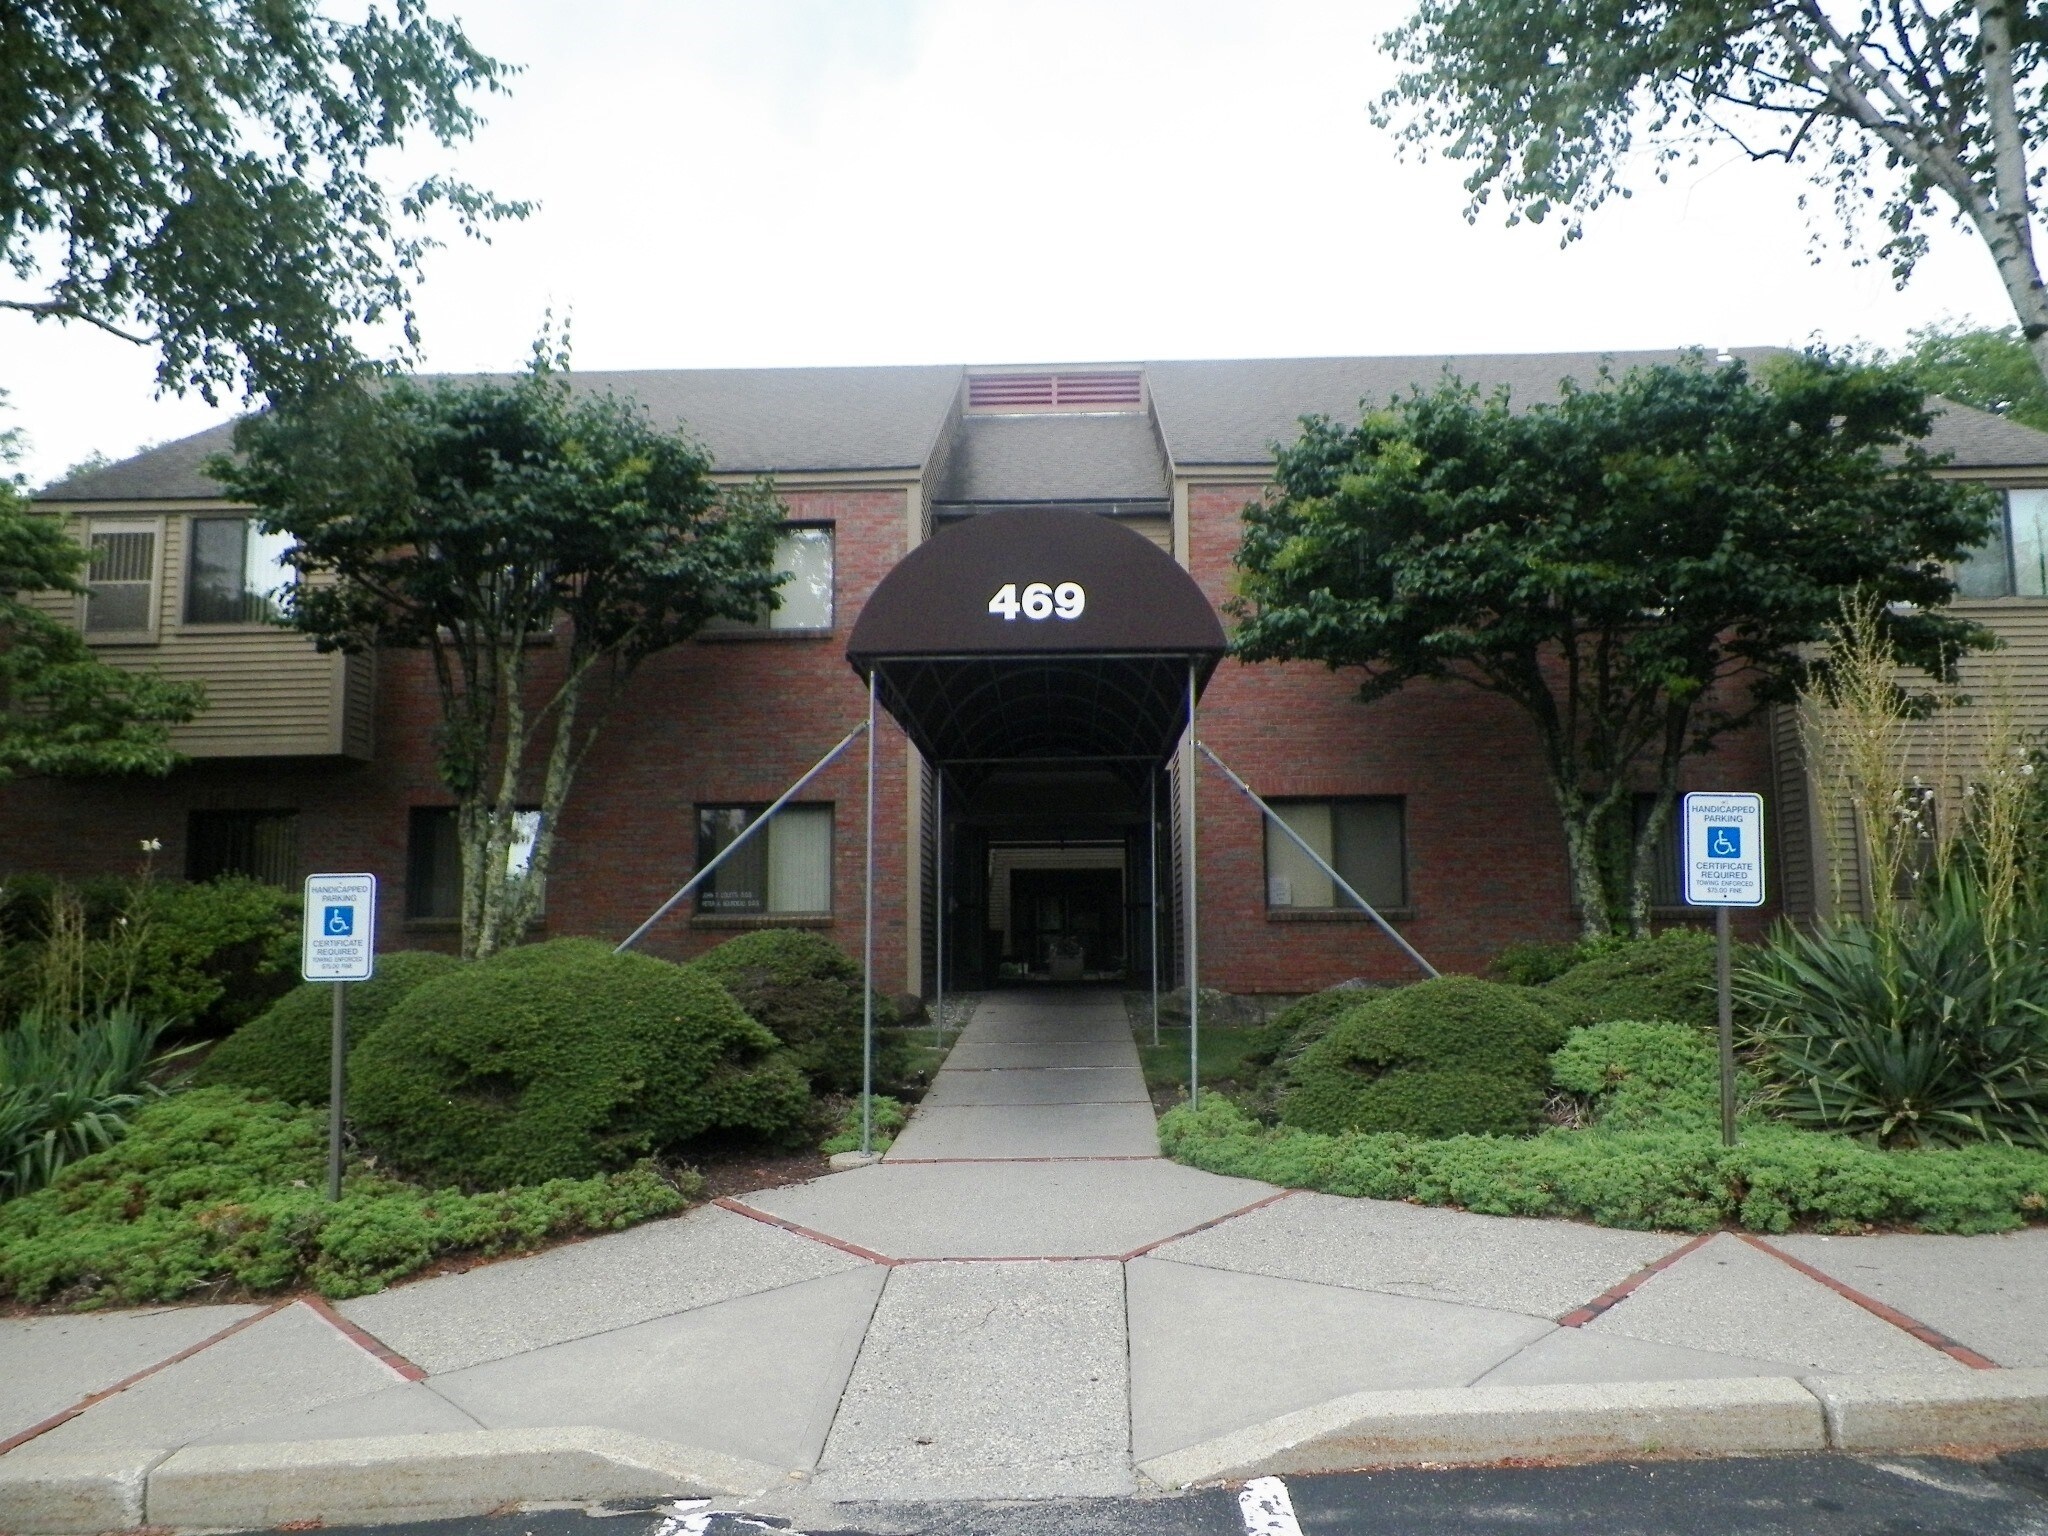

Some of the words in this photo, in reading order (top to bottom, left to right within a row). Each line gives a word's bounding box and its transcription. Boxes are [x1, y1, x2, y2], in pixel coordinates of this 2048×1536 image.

[988, 581, 1086, 620] 469
[1691, 805, 1756, 814] HANDICAPPED
[1704, 814, 1744, 823] PARKING
[1696, 861, 1753, 870] CERTIFICATE
[1701, 871, 1748, 879] REQUIRED
[311, 885, 368, 893] HANDICAPPED
[321, 894, 357, 902] PARKING
[313, 939, 363, 947] CERTIFICATE
[317, 948, 359, 956] REQUIRED
